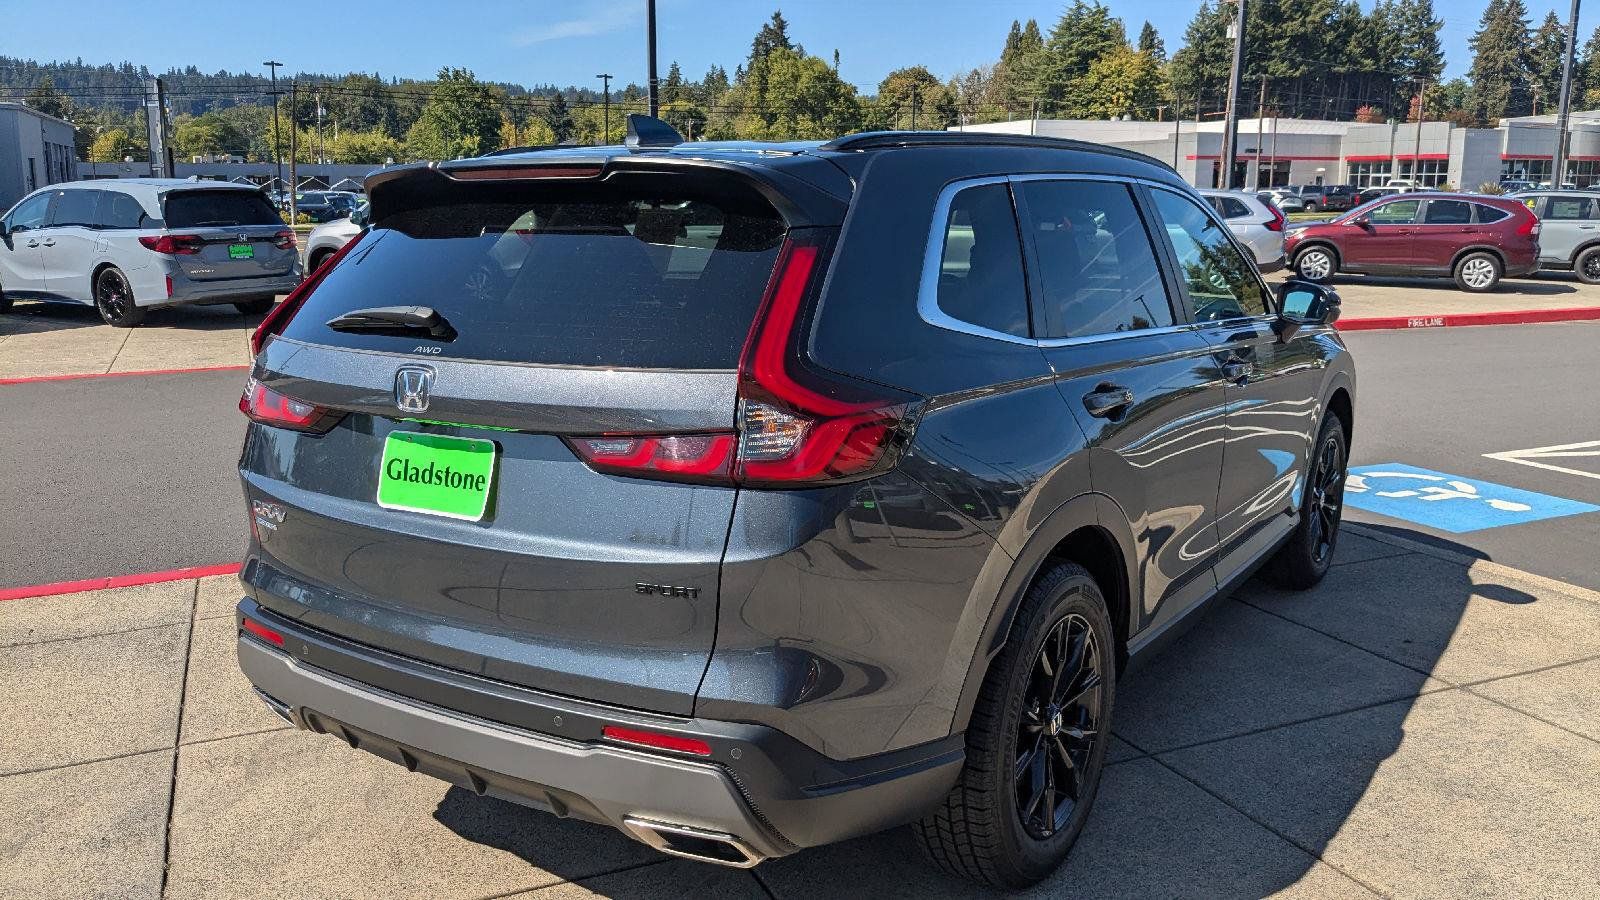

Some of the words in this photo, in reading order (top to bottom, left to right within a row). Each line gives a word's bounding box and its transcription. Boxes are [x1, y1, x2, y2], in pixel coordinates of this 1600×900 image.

[1407, 317, 1424, 327] FIRE
[1425, 317, 1444, 327] LANE
[413, 345, 442, 354] AWD
[386, 457, 486, 492] Gladstone
[635, 582, 702, 599] SPORT
